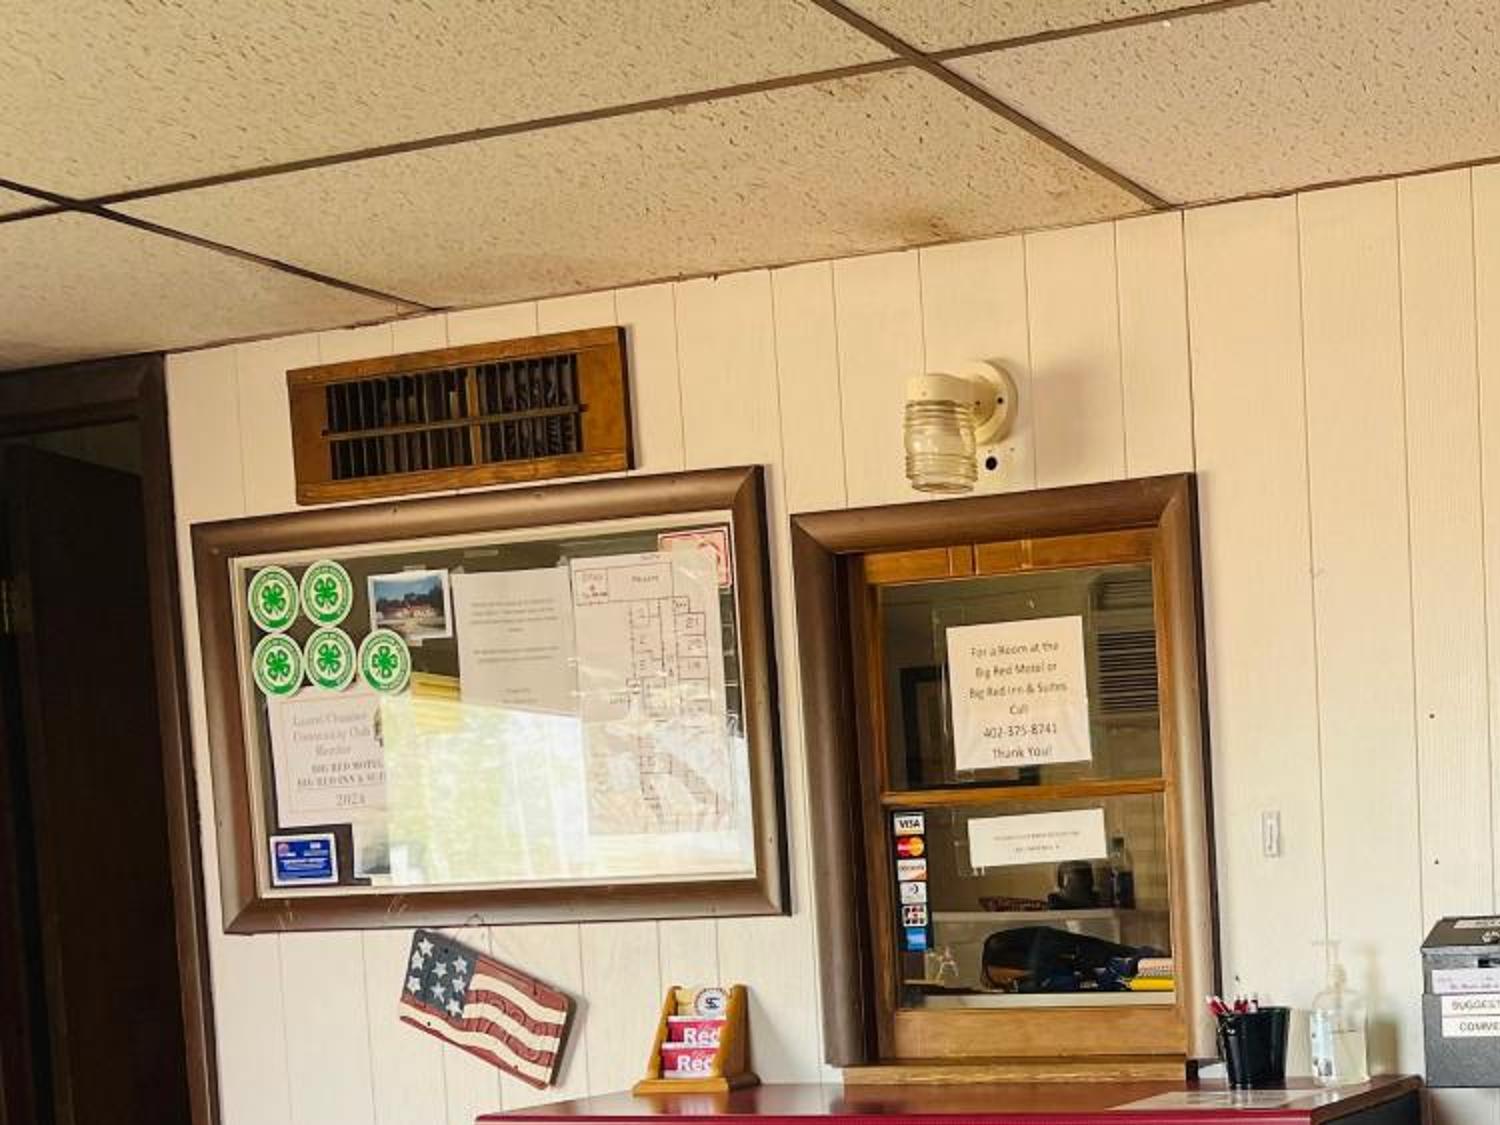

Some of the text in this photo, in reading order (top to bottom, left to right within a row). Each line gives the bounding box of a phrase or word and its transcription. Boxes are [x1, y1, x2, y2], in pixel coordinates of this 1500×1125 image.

[970, 647, 988, 657] For
[999, 645, 1028, 655] Room
[1030, 643, 1041, 653] at
[1042, 641, 1060, 652] the
[975, 663, 1058, 678] Big Red Motel or
[969, 682, 1068, 700] Big Red Inn & Suites
[1009, 703, 1029, 715] Call
[993, 747, 1024, 759] Thank
[331, 761, 350, 772] RED
[899, 819, 921, 829] VISA
